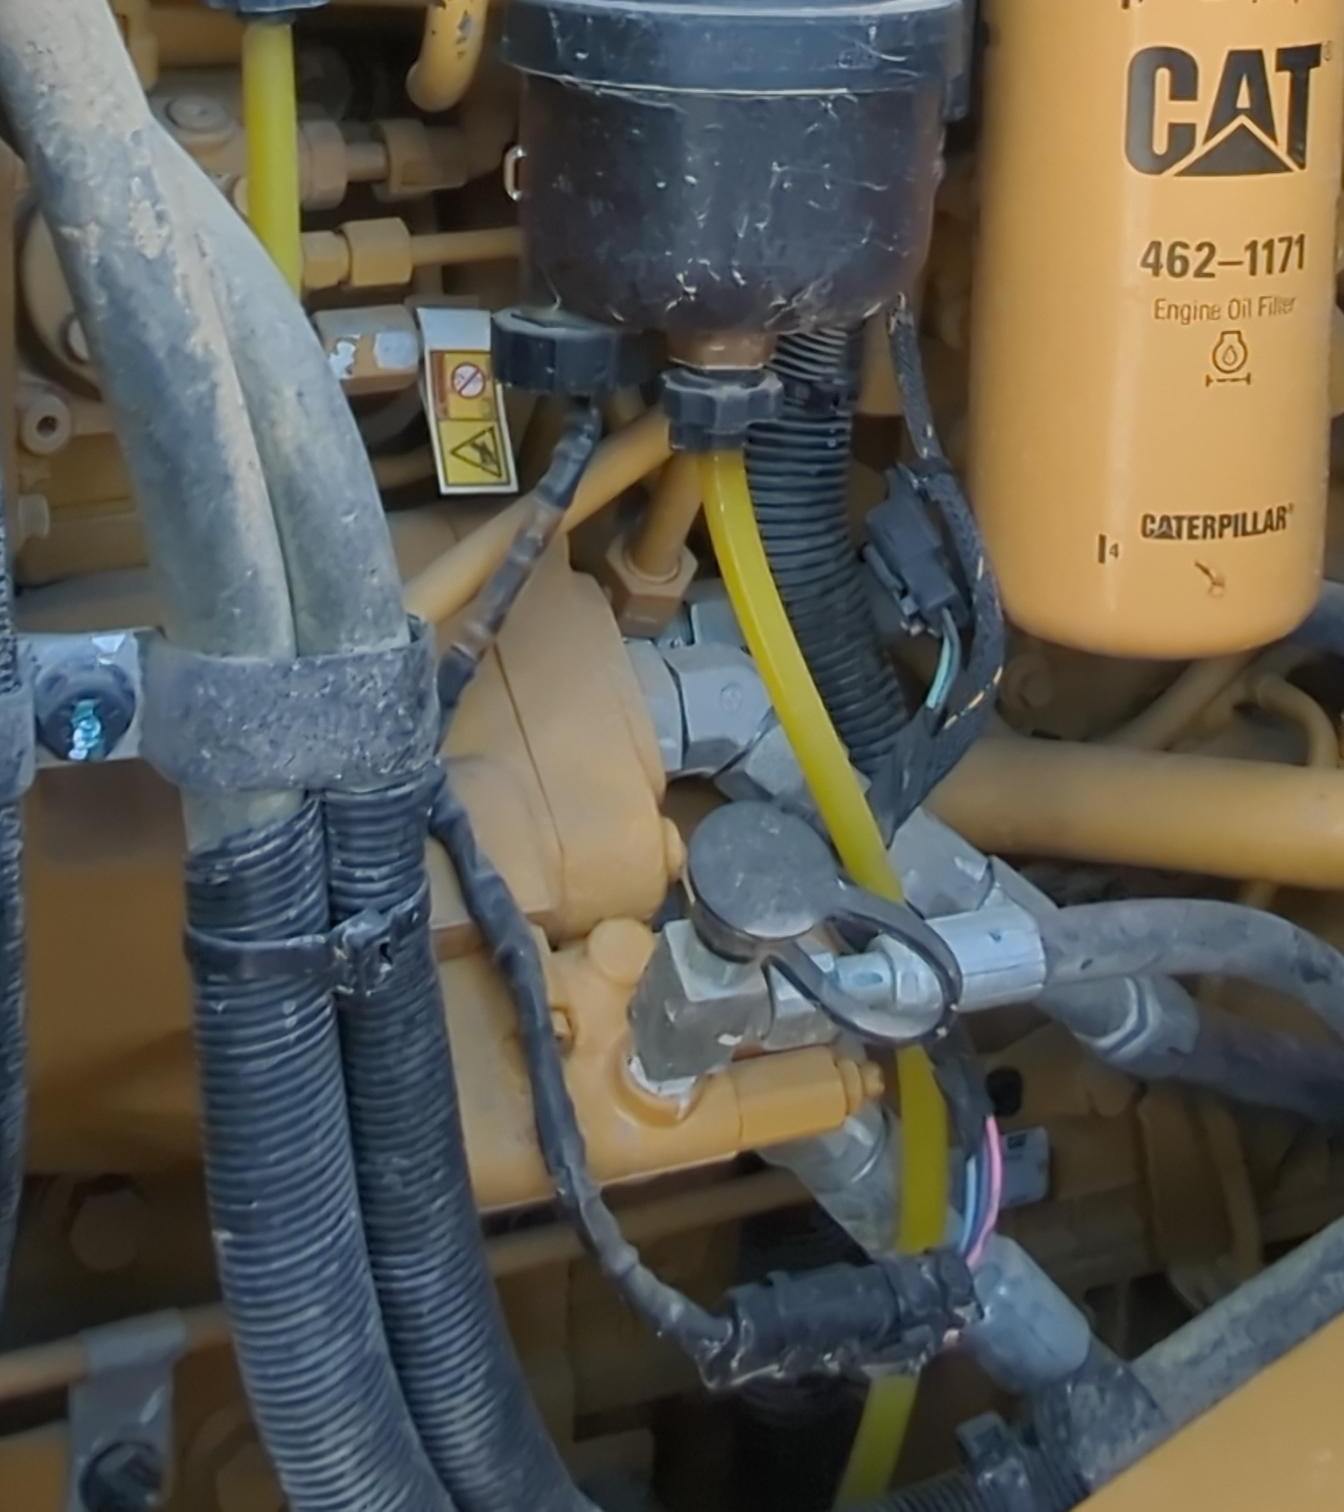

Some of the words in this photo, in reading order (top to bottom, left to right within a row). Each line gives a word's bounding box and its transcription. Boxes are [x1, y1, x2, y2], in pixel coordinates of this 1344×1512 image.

[1139, 233, 1306, 279] 462-1171
[1154, 298, 1222, 326] Engine
[1227, 296, 1253, 321] Oil
[1257, 295, 1297, 318] Filter
[1141, 506, 1287, 541] CATERPILLAR
